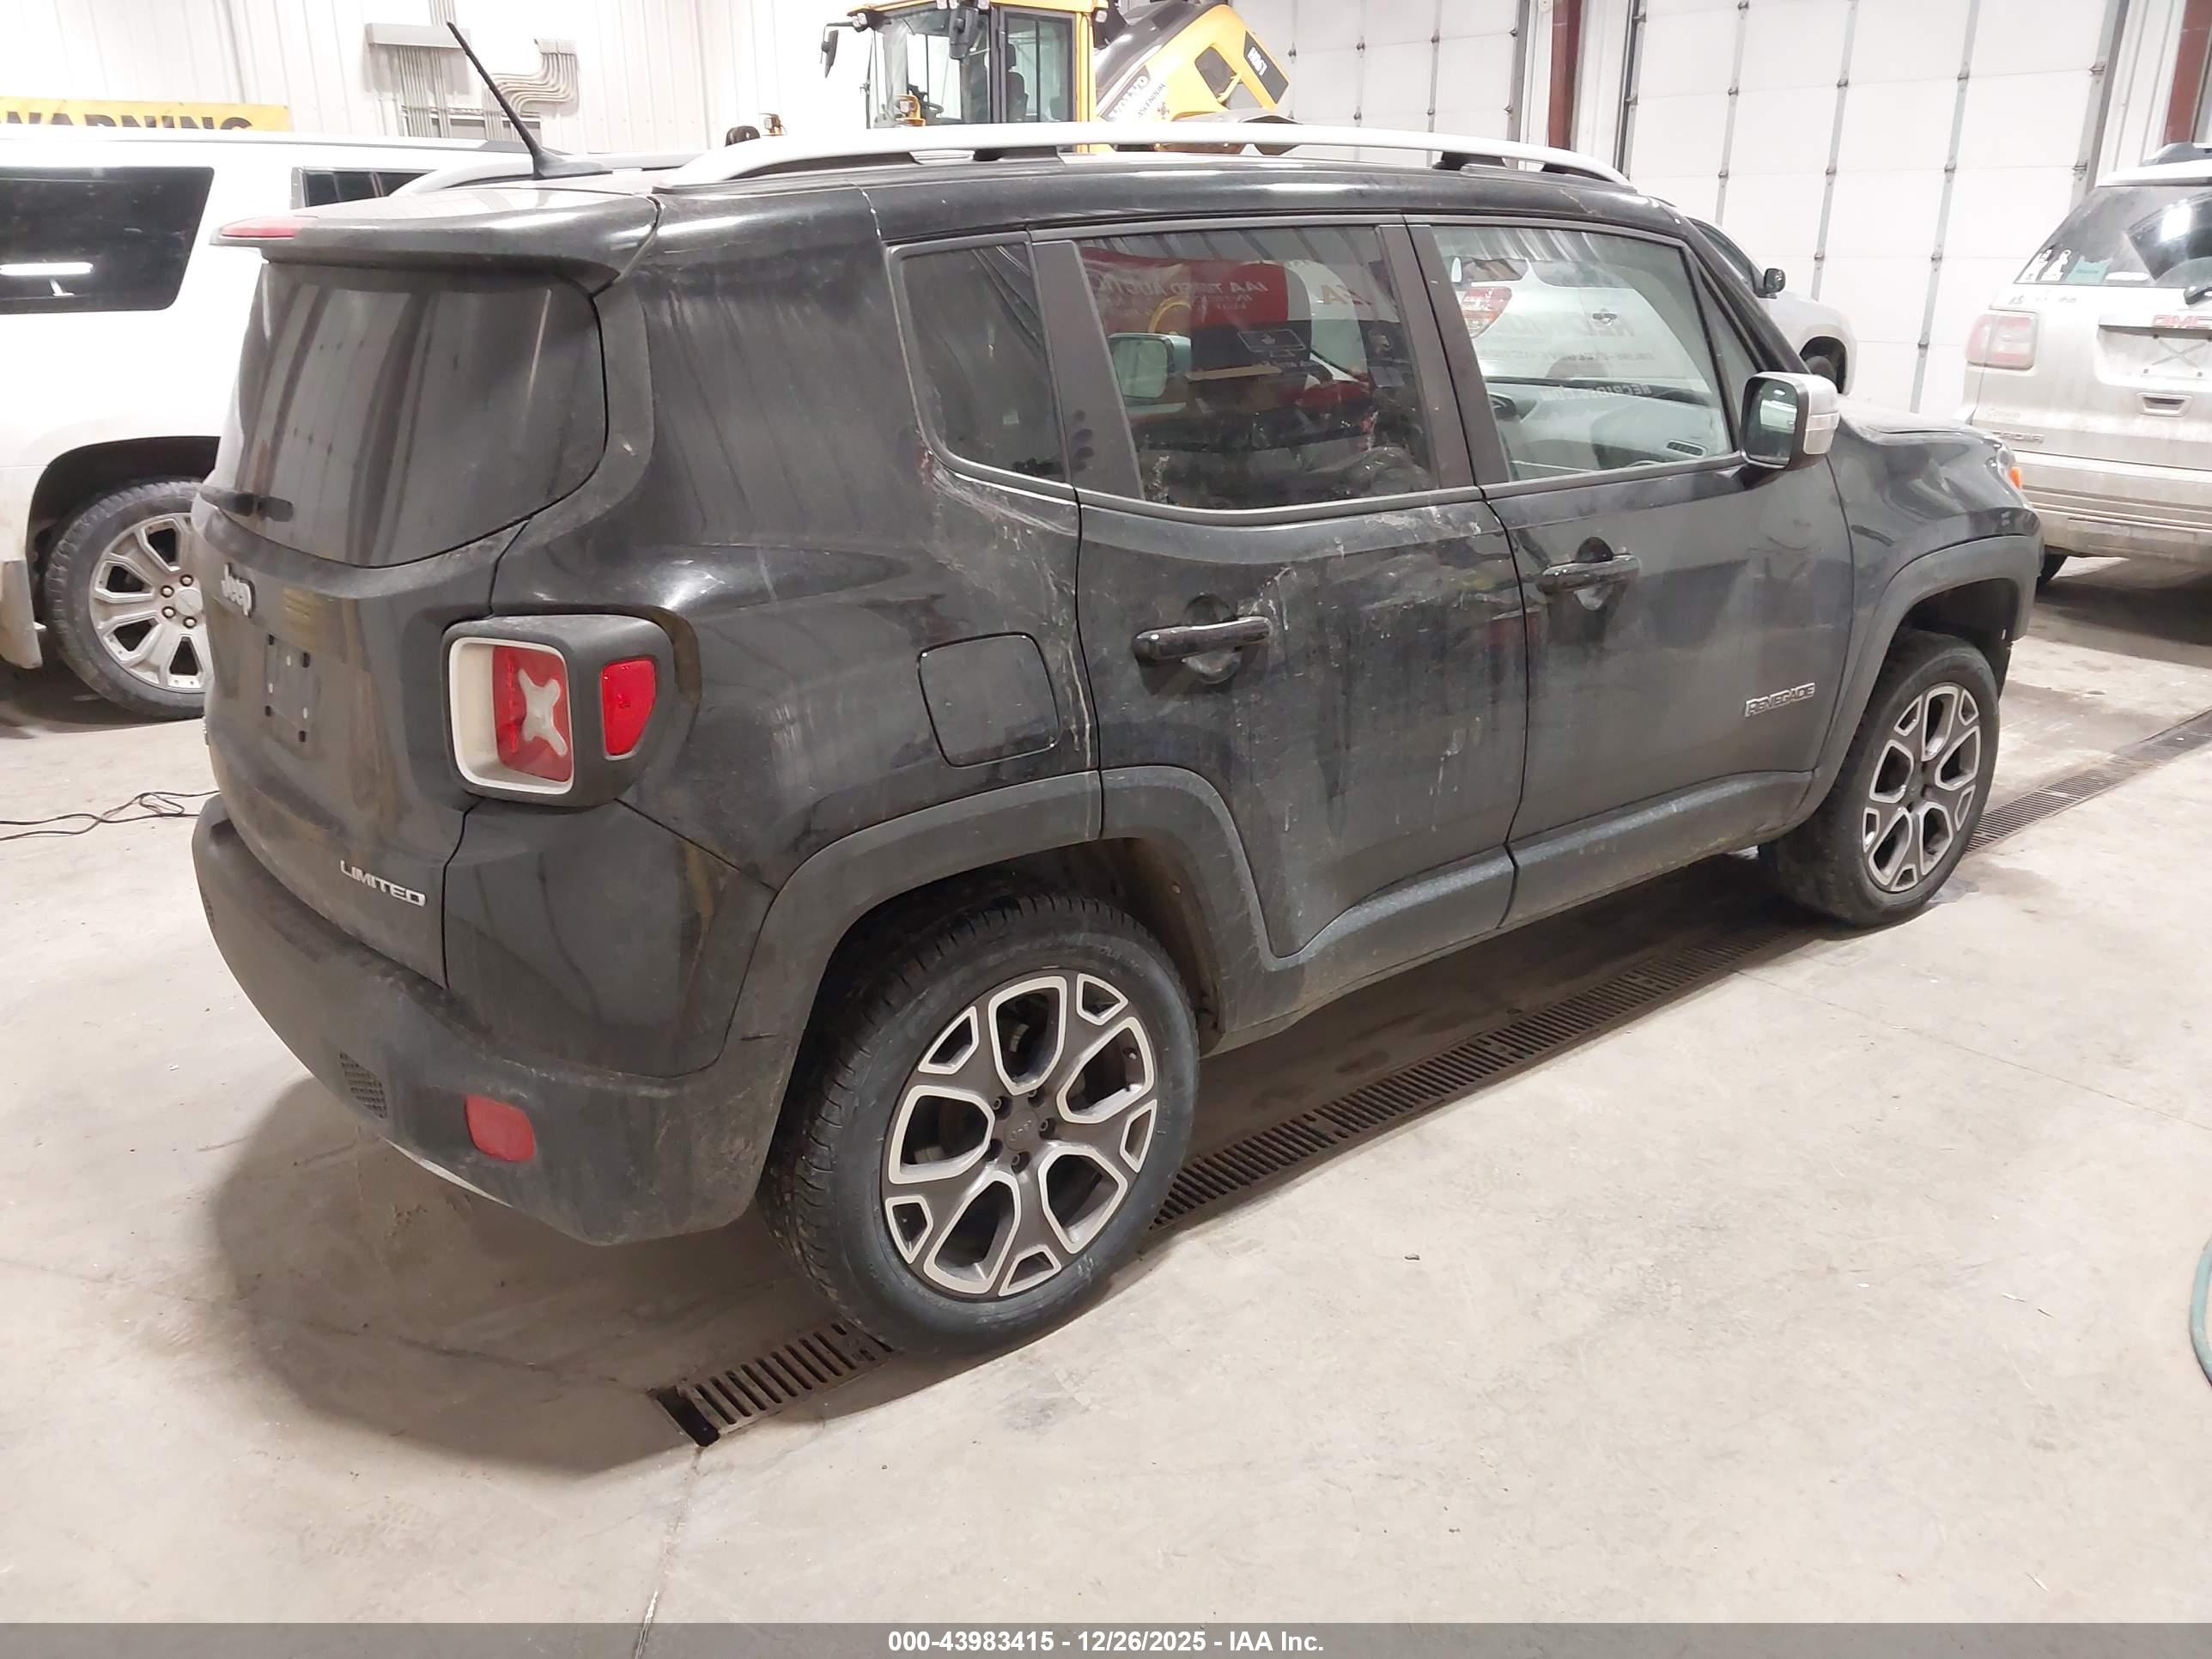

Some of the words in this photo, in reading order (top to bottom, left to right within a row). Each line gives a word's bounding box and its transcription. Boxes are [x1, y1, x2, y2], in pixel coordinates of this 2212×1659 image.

[2153, 314, 2212, 329] GMC
[1744, 682, 1815, 718] RENEGADE
[340, 860, 426, 907] LIMITED
